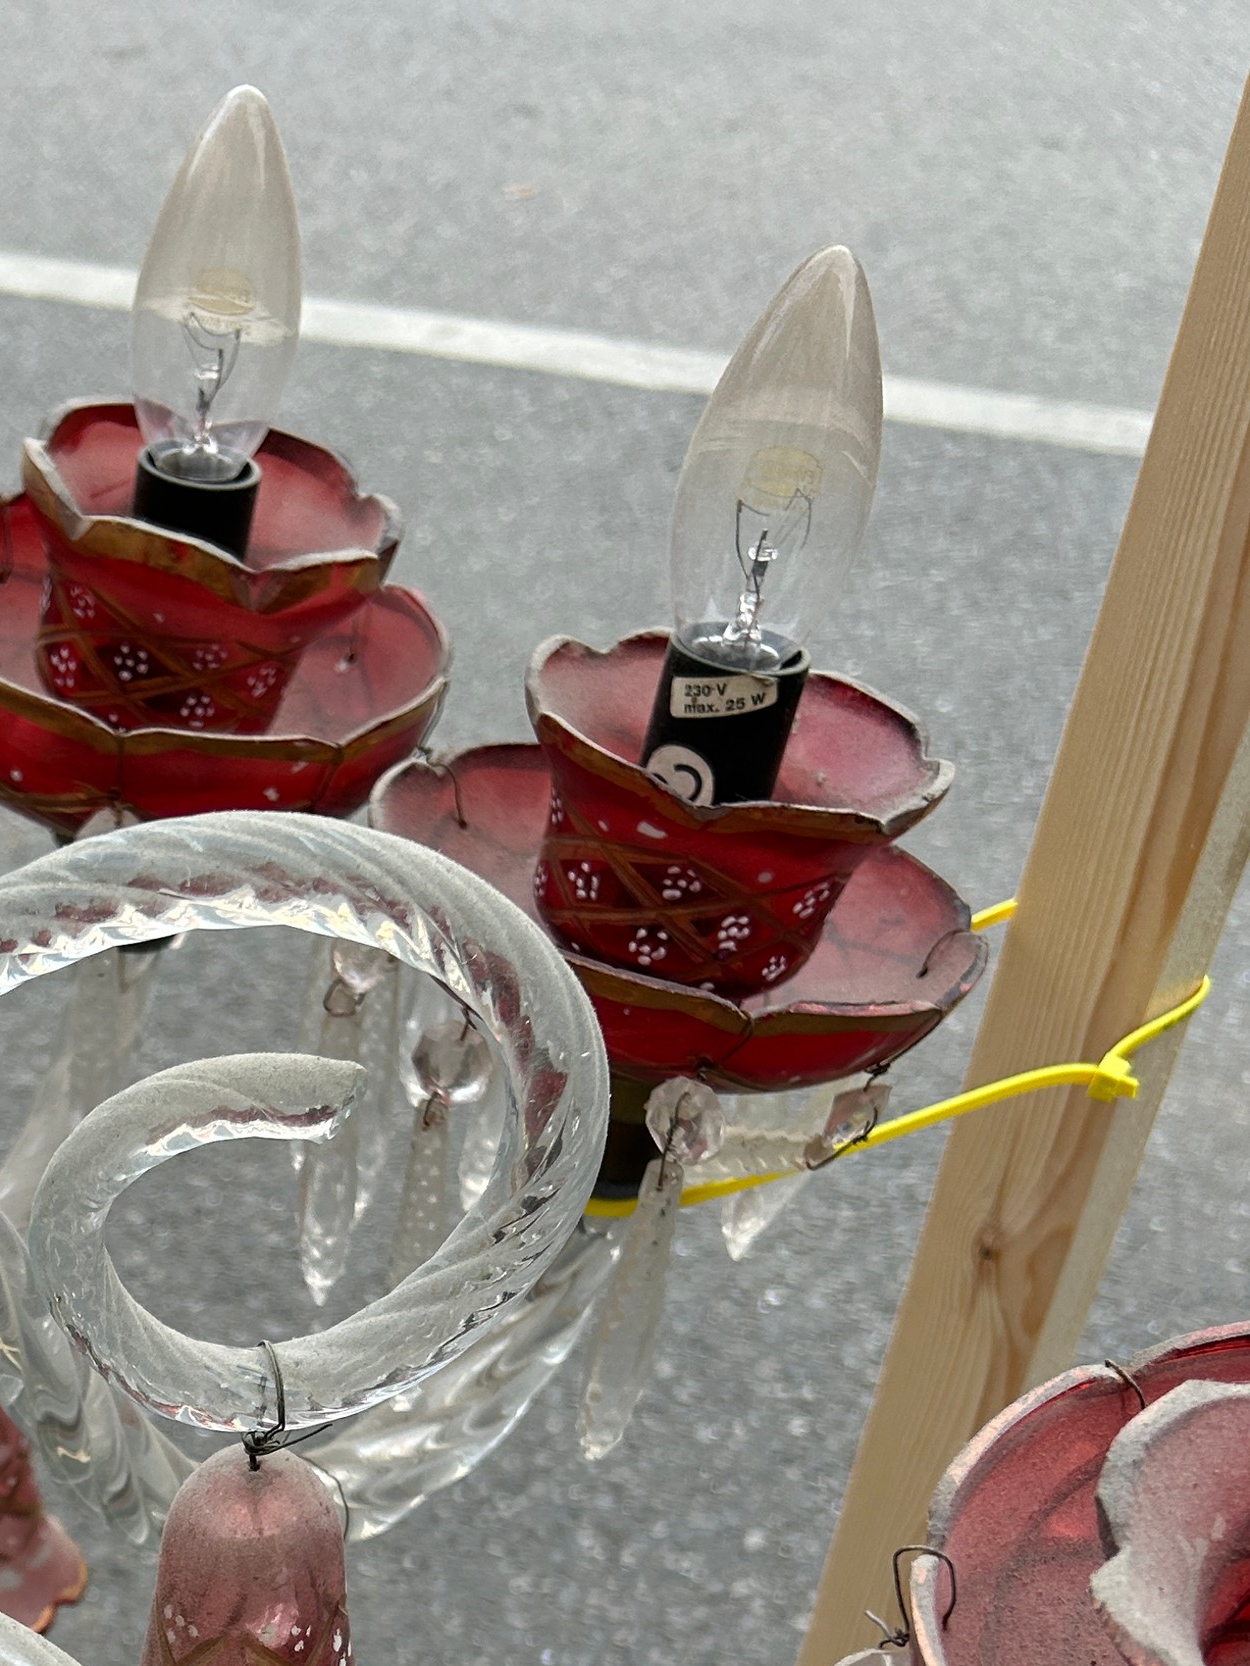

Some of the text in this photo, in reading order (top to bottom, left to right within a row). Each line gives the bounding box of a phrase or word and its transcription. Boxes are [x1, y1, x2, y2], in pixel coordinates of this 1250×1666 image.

[684, 683, 727, 697] 230 V
[684, 692, 766, 713] max. 25 W
